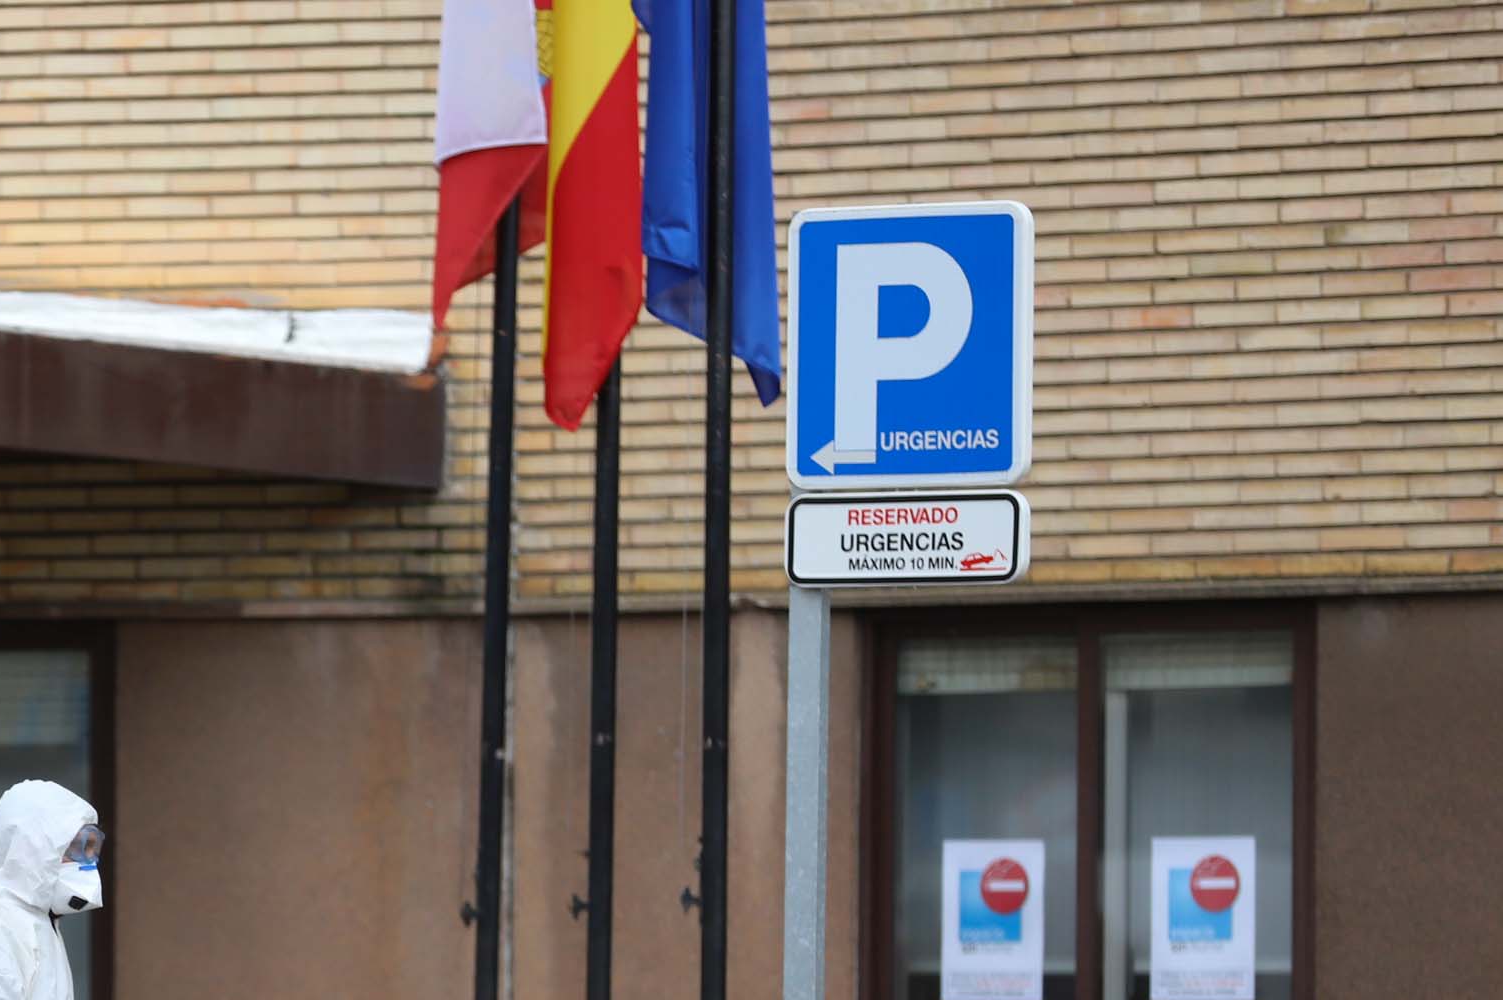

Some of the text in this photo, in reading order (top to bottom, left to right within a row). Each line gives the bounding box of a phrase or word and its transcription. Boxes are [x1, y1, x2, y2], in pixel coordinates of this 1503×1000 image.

[834, 241, 974, 452] P
[880, 429, 1000, 451] URGENCIAS
[848, 507, 958, 526] RESERVADO
[840, 532, 964, 552] URGENCIAS
[848, 554, 958, 571] MÁXIMO 10 MIN.
